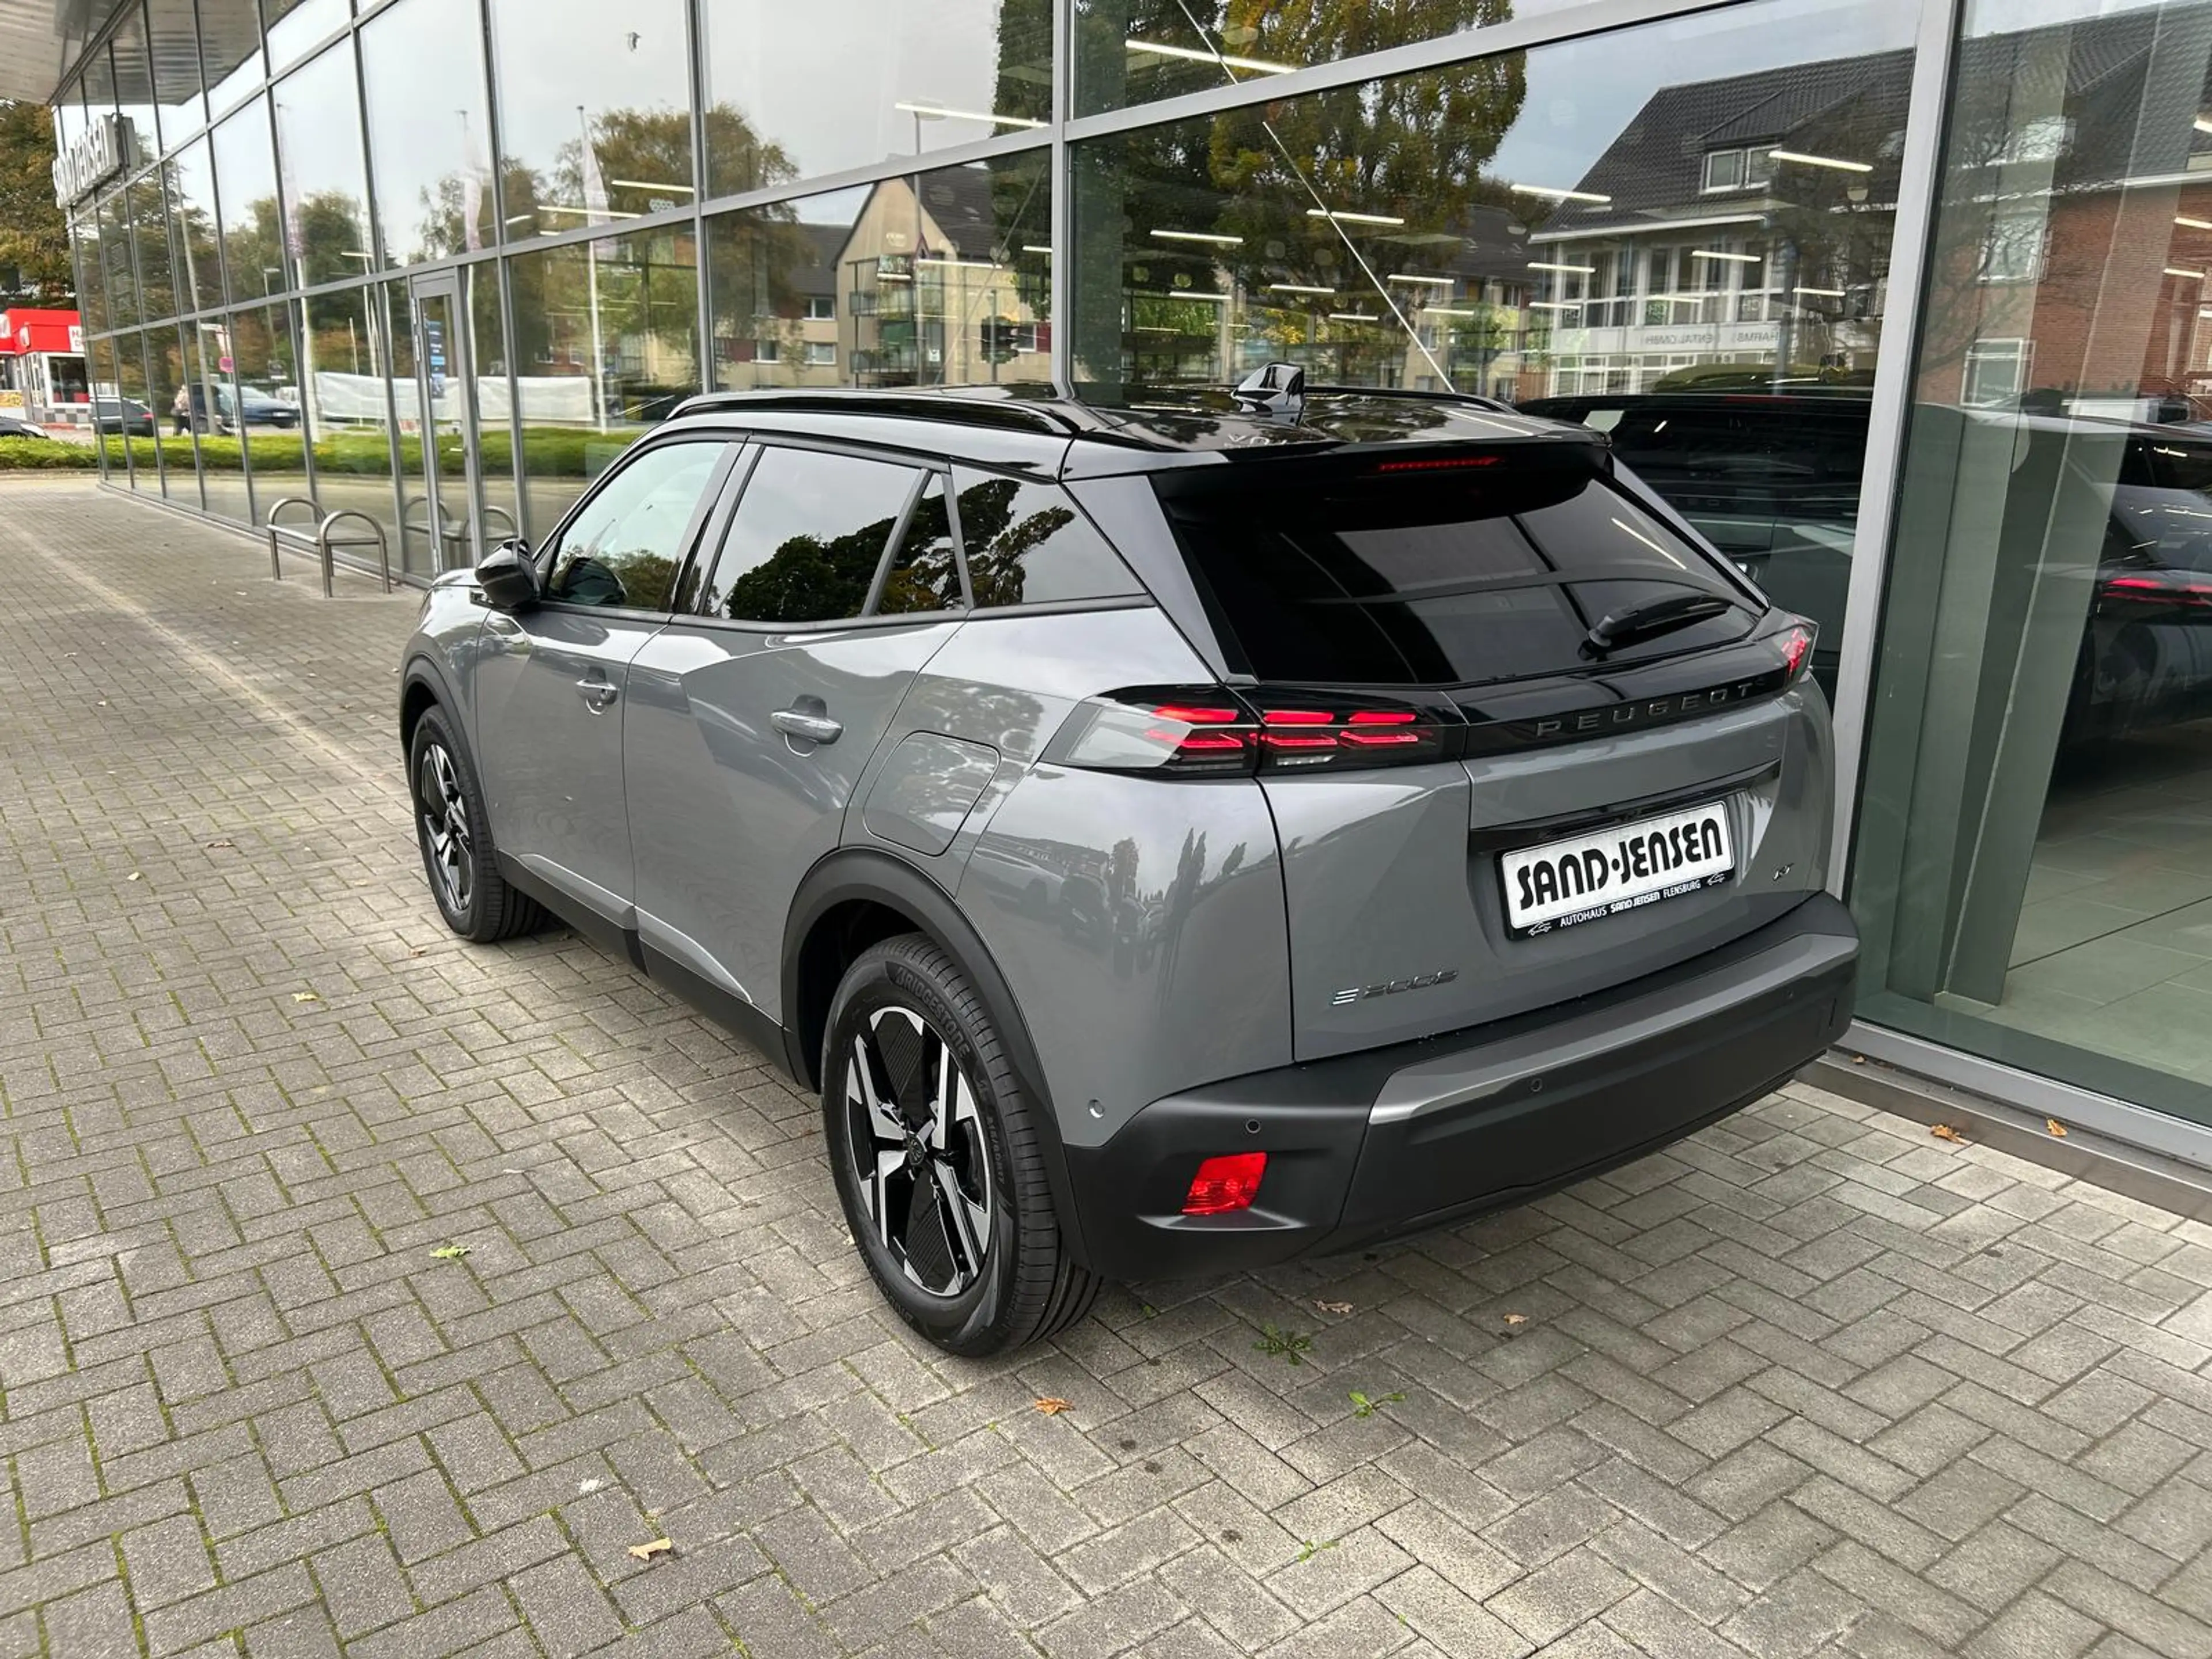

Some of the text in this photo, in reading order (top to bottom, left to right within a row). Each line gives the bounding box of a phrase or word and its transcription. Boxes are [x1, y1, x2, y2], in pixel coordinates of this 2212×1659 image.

[1536, 683, 1753, 737] PEUGEOT
[1560, 908, 1607, 927] AUTOHAUS
[1663, 880, 1701, 899] FLENSBURG
[896, 967, 970, 1058] BRIDGESTONE
